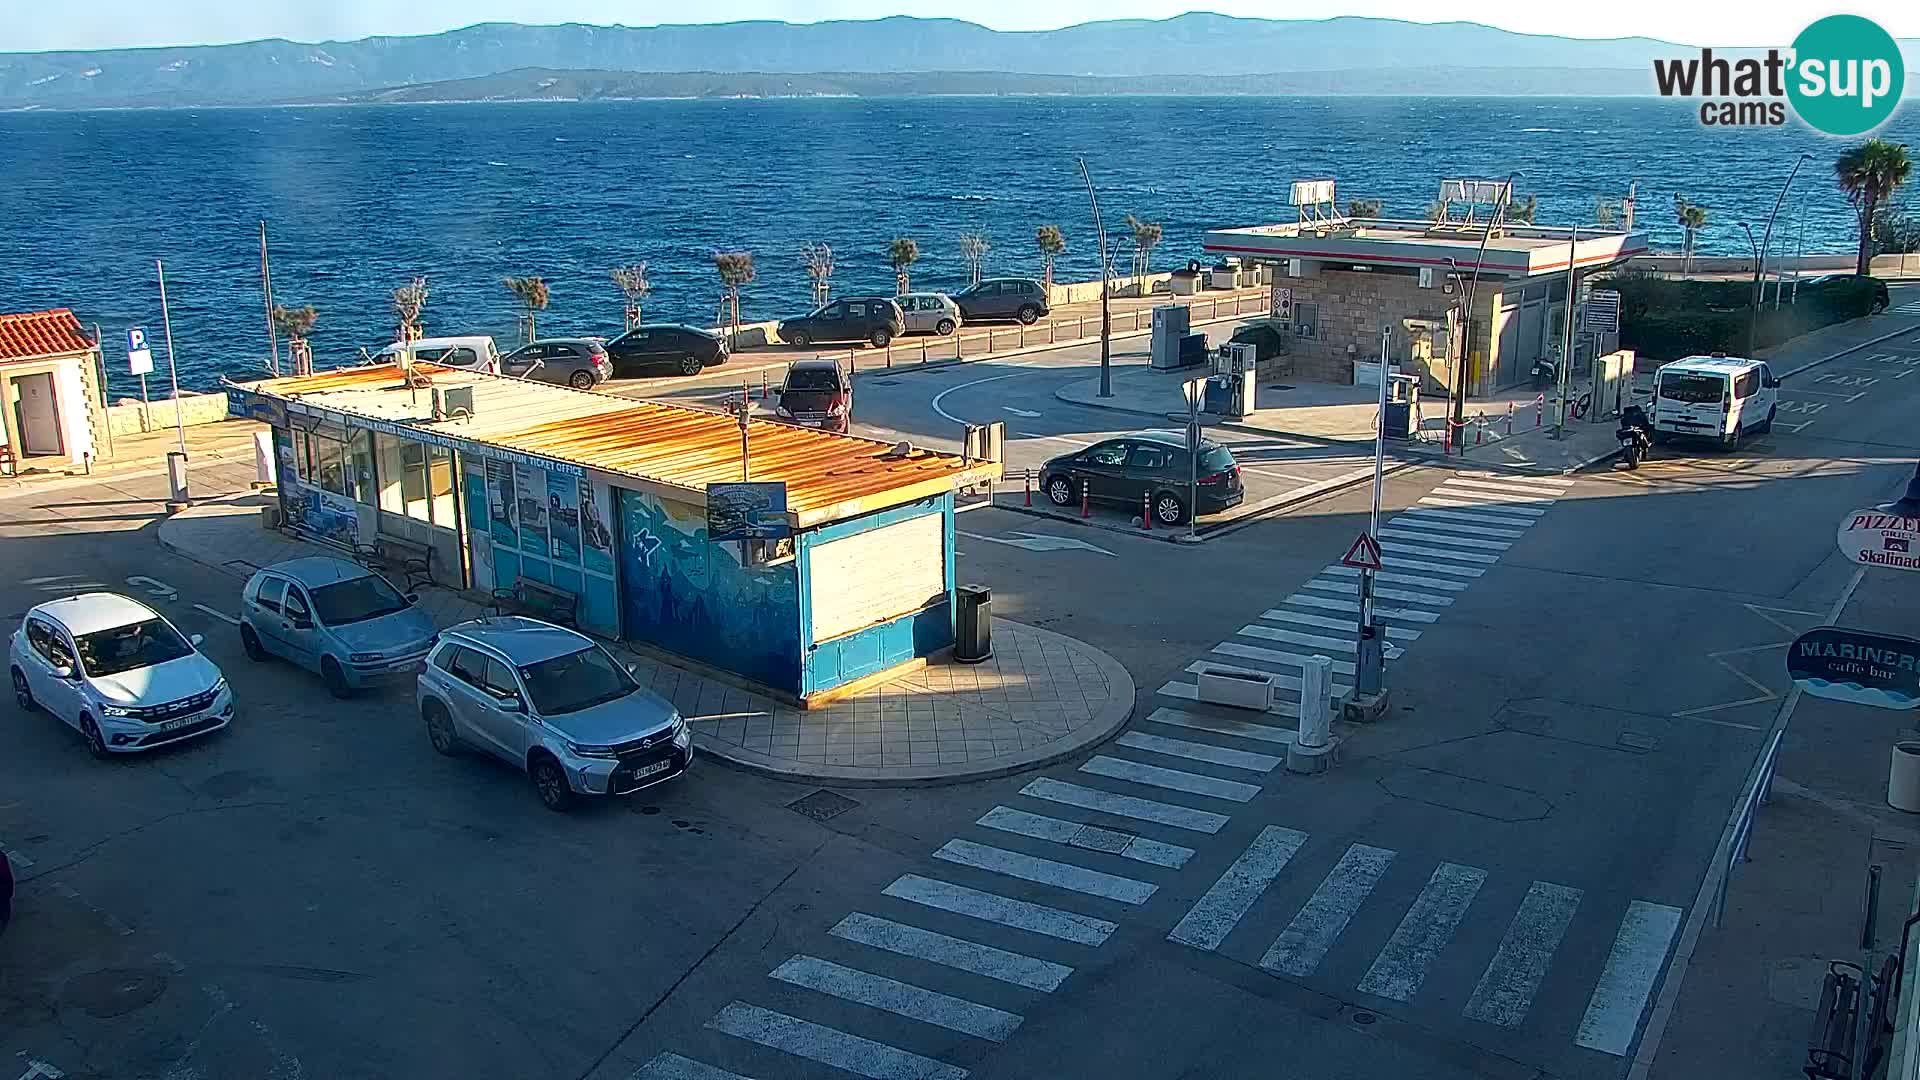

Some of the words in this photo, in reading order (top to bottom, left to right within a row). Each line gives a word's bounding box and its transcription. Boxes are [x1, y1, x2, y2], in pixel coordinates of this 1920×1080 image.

[131, 330, 145, 350] P
[1813, 373, 1881, 388] TAXI
[1776, 400, 1829, 416] AXI
[397, 428, 437, 444] AUTOBUSNA
[479, 446, 494, 457] BUS
[496, 450, 527, 464] STATION
[530, 457, 554, 470] TICKET
[556, 463, 583, 476] OFFICE
[1881, 530, 1916, 540] GRILL
[1828, 662, 1864, 674] caffe
[1870, 665, 1896, 679] bar
